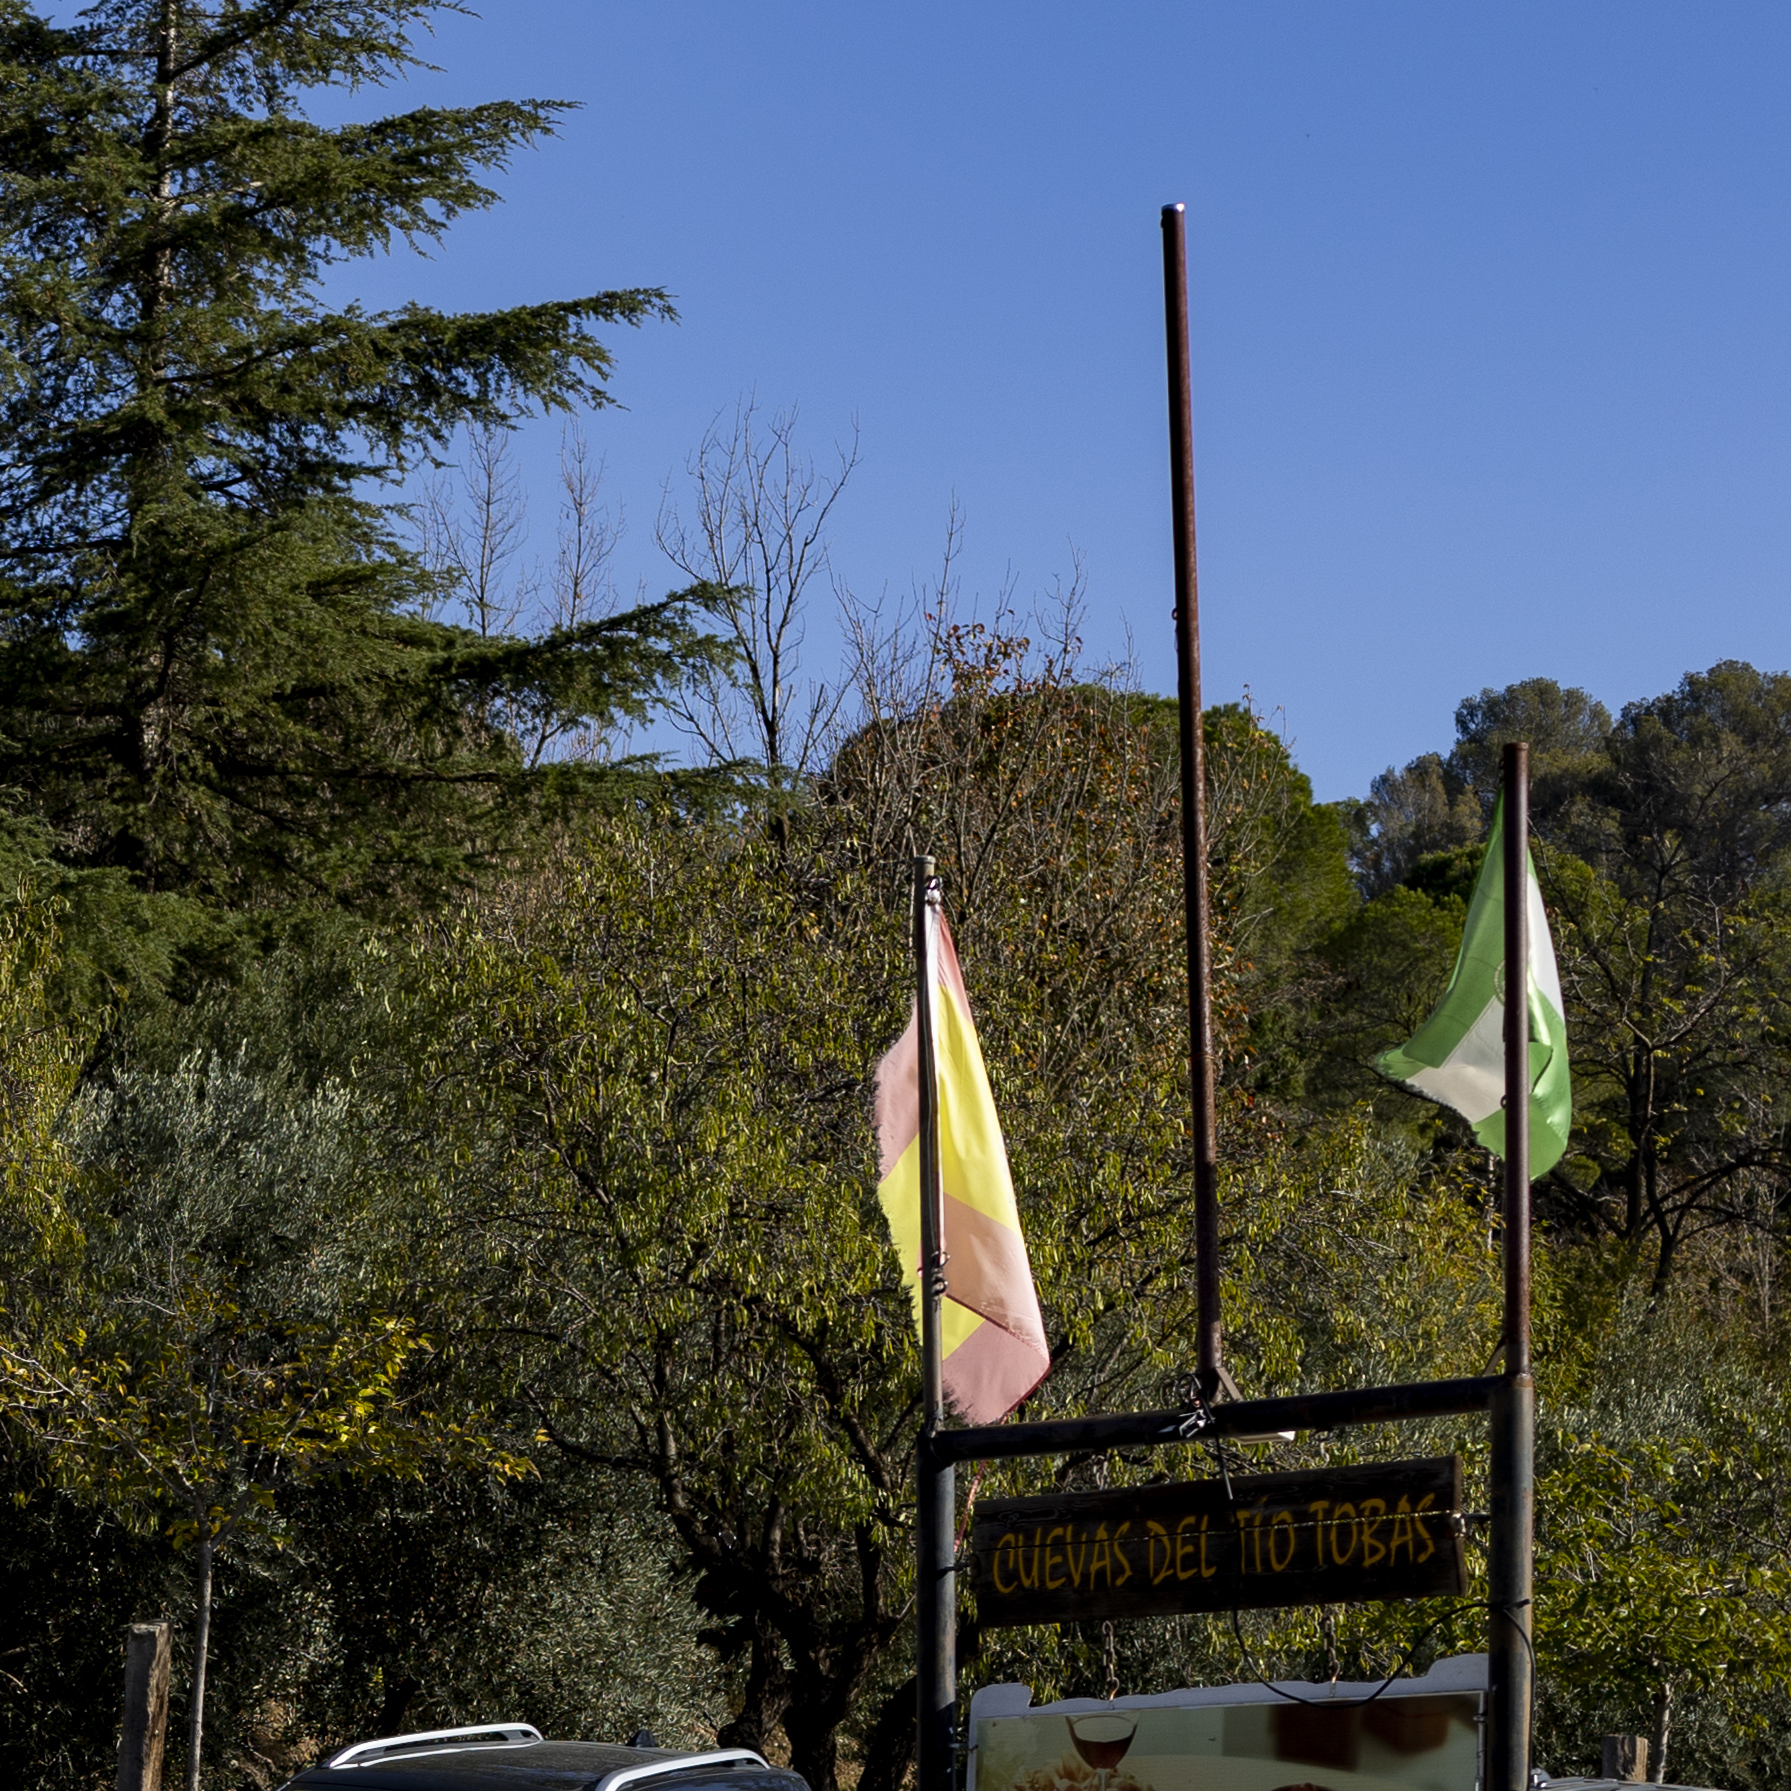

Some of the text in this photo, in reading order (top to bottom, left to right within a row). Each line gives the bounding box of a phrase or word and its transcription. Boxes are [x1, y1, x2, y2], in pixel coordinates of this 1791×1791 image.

[993, 1520, 1133, 1594] CUEVAS
[1147, 1514, 1216, 1585] DEL
[1308, 1492, 1436, 1568] TOBAS
